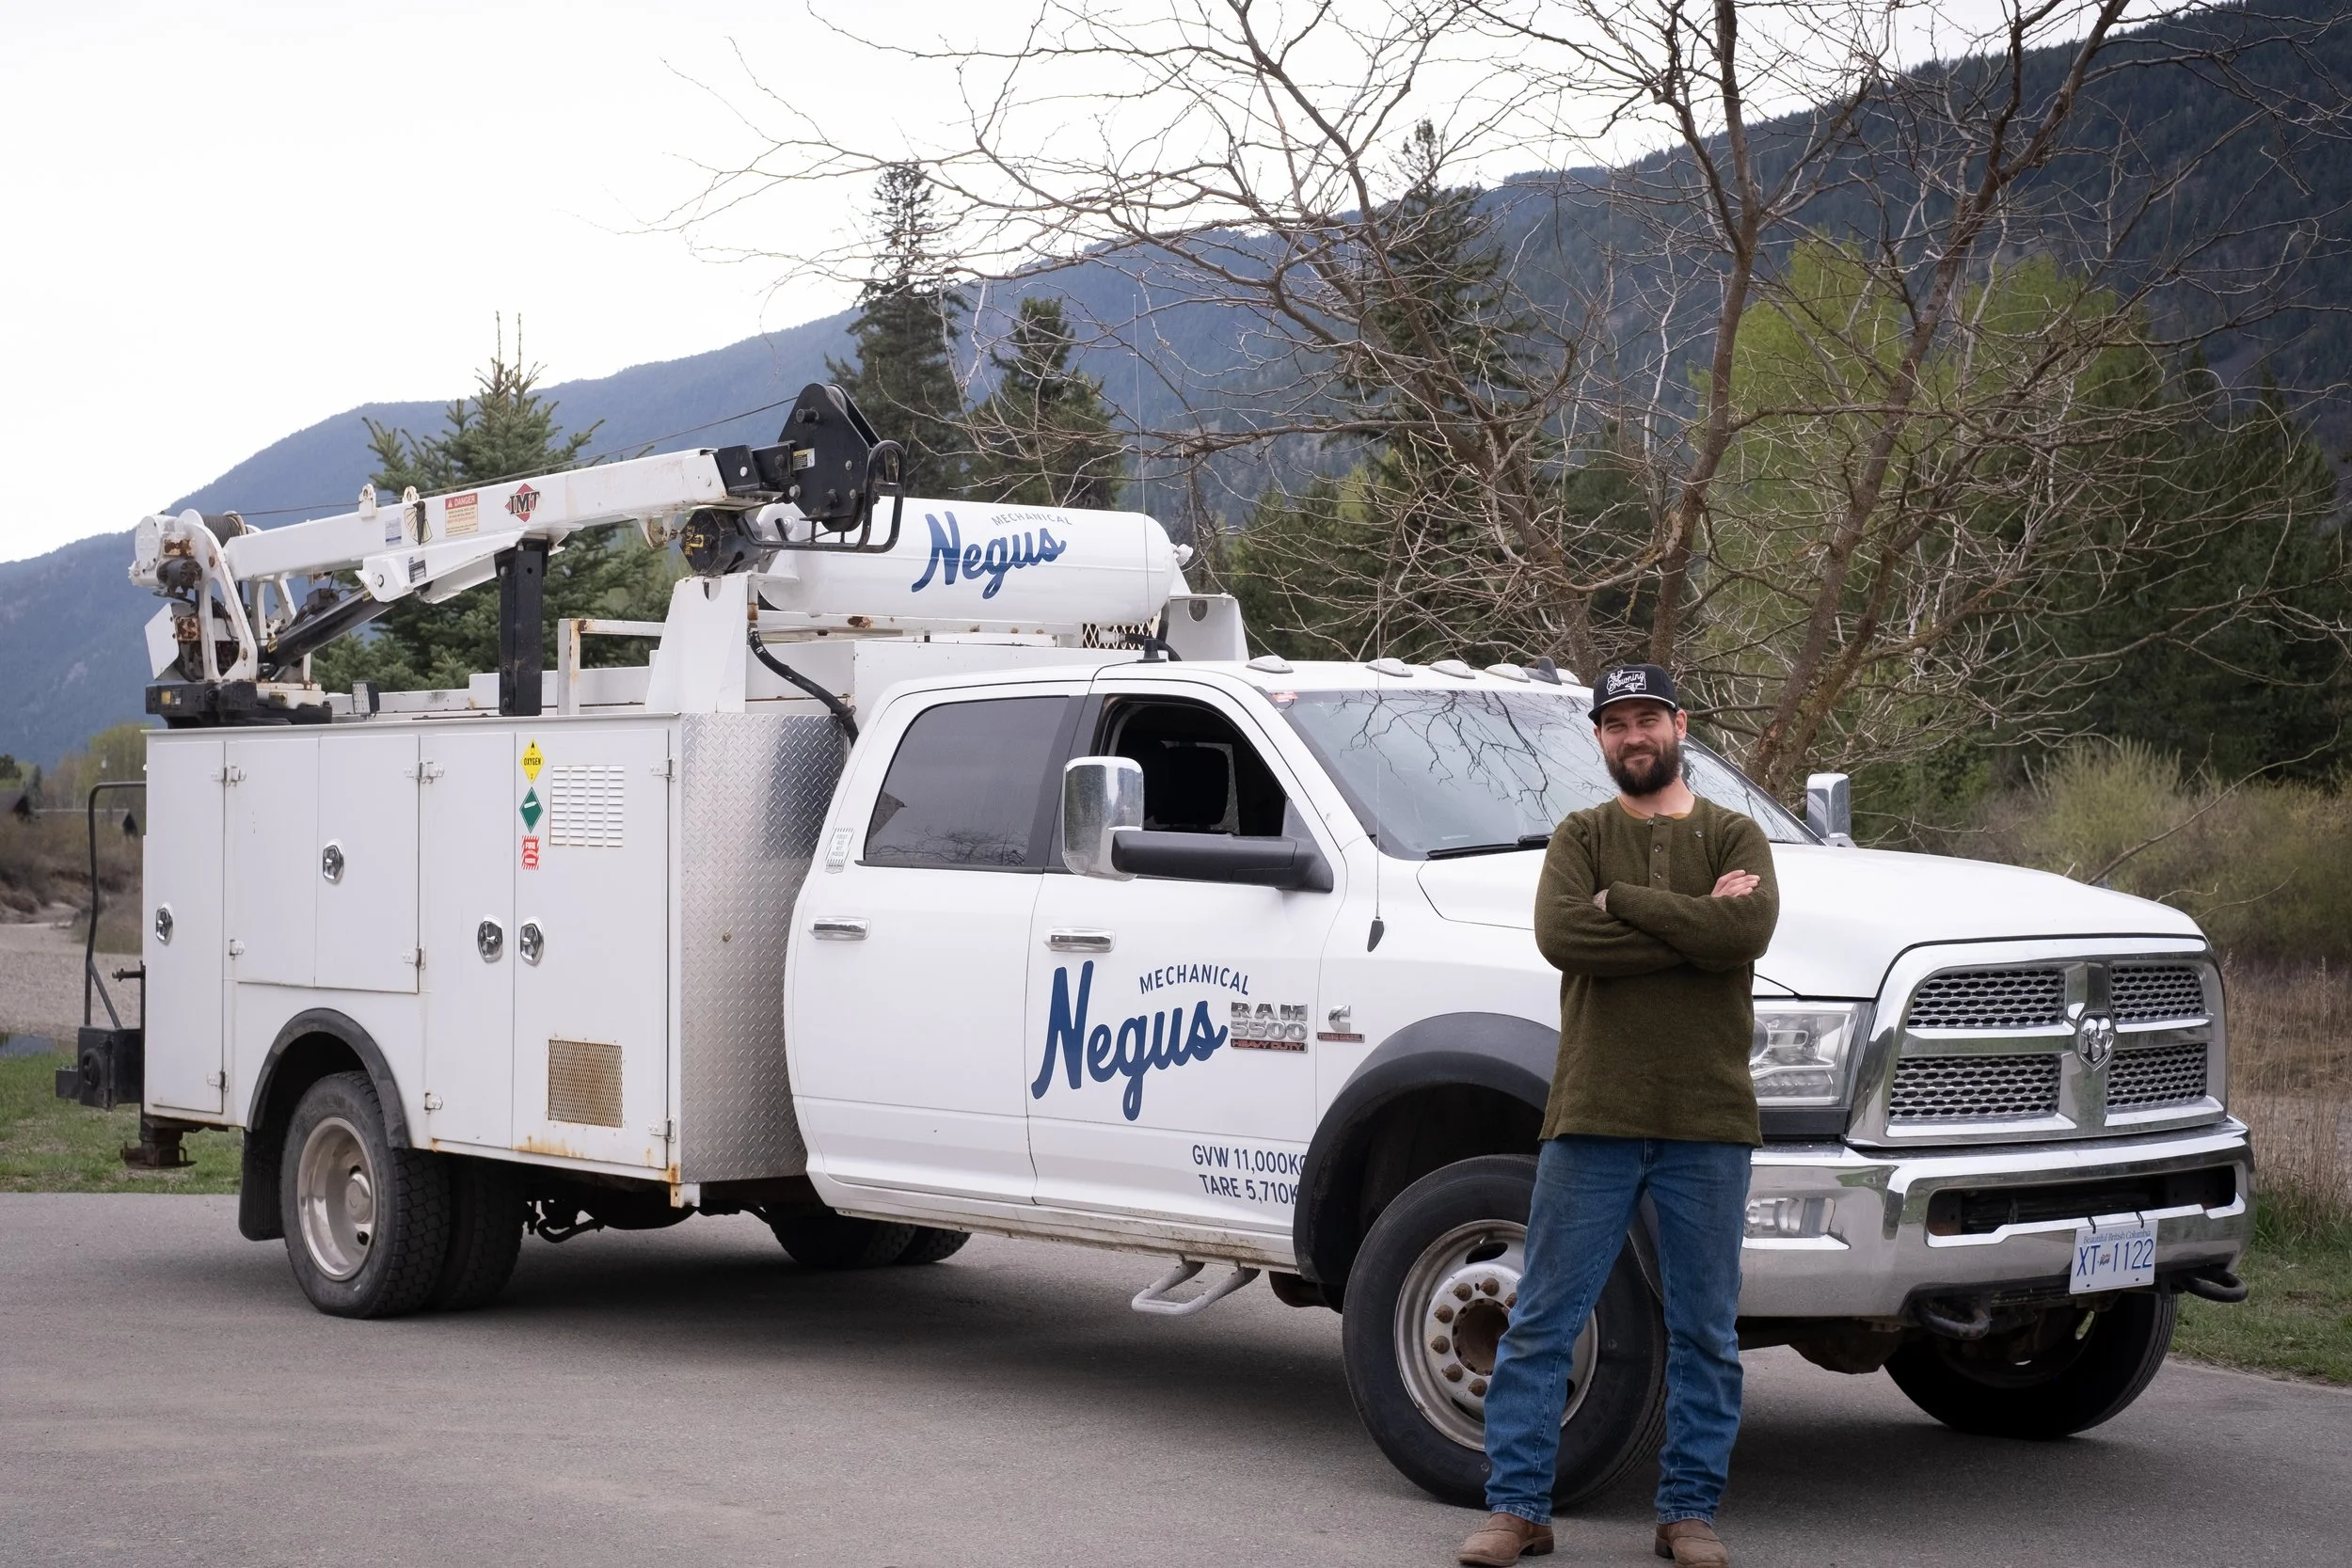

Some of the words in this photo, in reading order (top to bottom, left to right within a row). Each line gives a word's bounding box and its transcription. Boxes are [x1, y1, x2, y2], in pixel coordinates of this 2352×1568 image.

[454, 495, 475, 506] DANGER
[509, 491, 540, 515] IMT
[991, 513, 1073, 526] MECHANICAL
[911, 511, 1067, 599] Negus
[523, 757, 541, 766] OXYGEN
[1139, 963, 1249, 996] MECHANICAL
[1231, 1001, 1308, 1022] RAM
[1030, 959, 1229, 1122] Negus
[1231, 1020, 1308, 1040] 5500
[1232, 1039, 1270, 1050] HEAVY
[1271, 1040, 1304, 1052] DUTY
[1192, 1144, 1229, 1168] GVW
[1199, 1174, 1241, 1198] TARE
[2107, 1231, 2125, 1243] British
[2126, 1230, 2151, 1240] Columbia
[2076, 1244, 2101, 1276] XT
[2113, 1238, 2153, 1273] 1122
